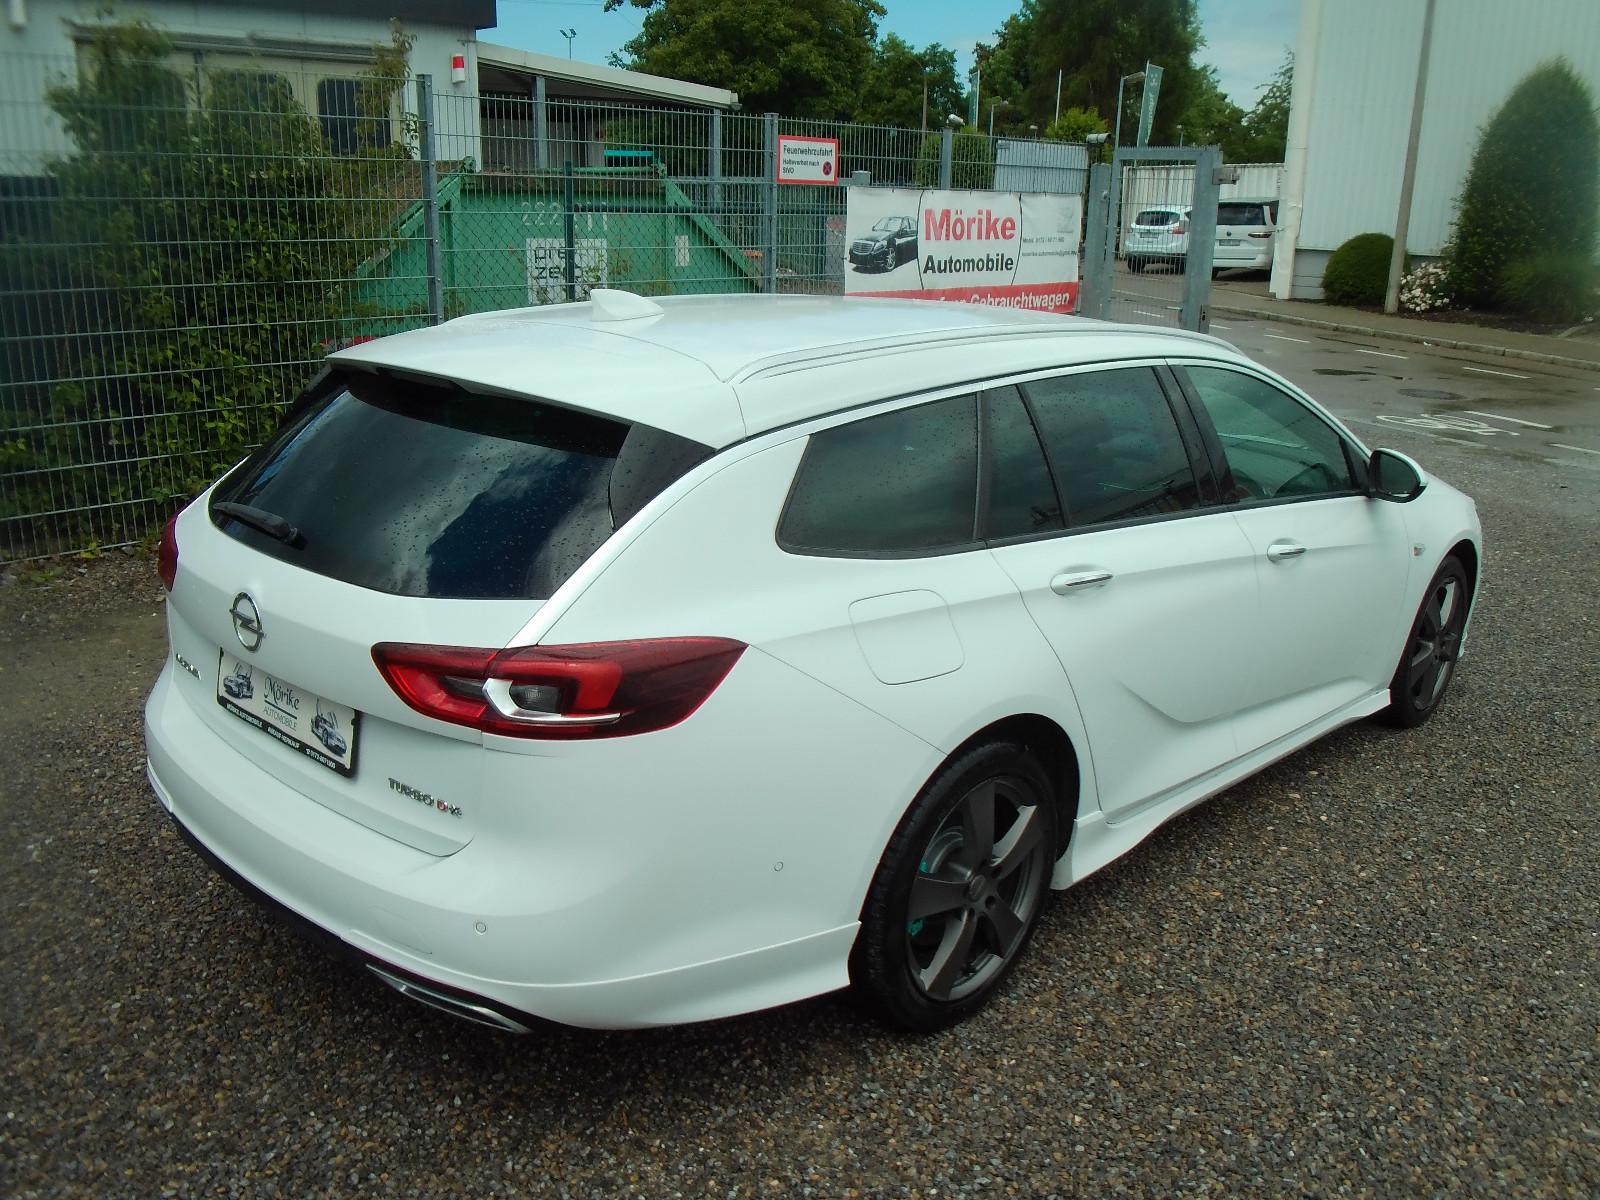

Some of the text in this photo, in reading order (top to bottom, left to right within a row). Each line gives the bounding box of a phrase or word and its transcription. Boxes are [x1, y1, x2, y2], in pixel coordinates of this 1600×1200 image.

[783, 144, 833, 157] Feuerwehrzufahrt
[924, 208, 1016, 241] Mörike
[923, 252, 1014, 274] Automobile
[263, 677, 300, 711] Mörike
[388, 777, 435, 806] TURBO
